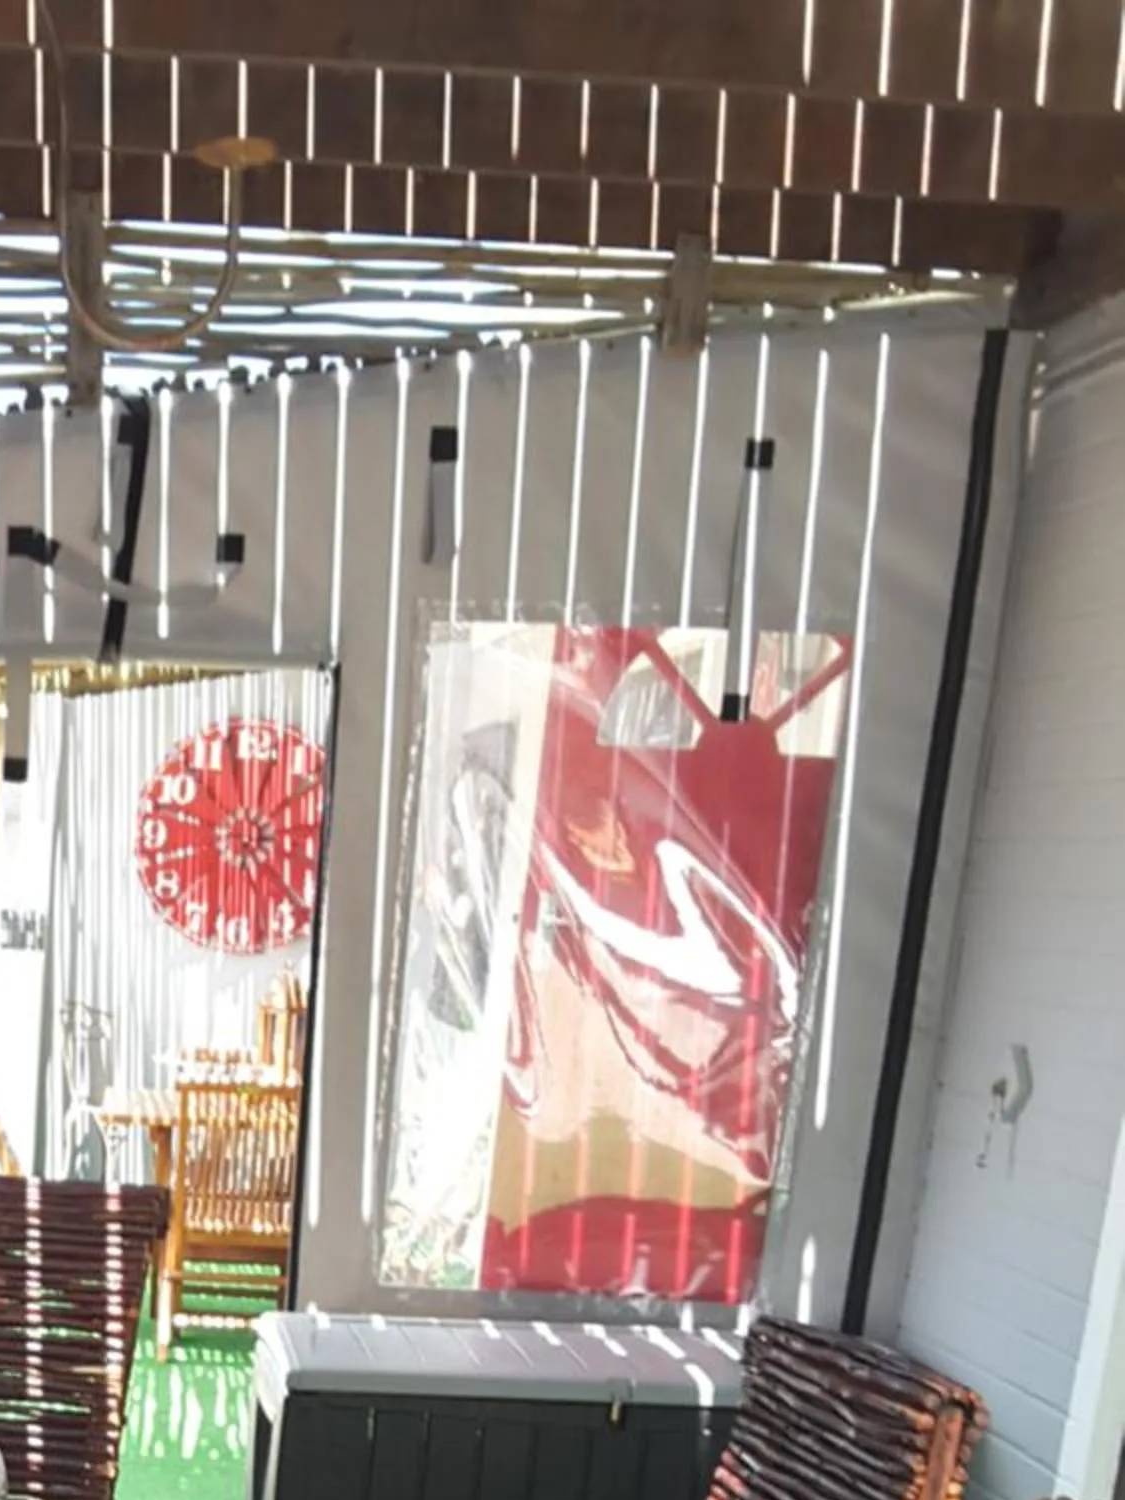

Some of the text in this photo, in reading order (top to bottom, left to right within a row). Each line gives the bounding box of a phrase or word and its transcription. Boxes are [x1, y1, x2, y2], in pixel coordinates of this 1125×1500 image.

[156, 773, 197, 805] 10
[142, 817, 168, 850] 9
[154, 868, 180, 901] 8
